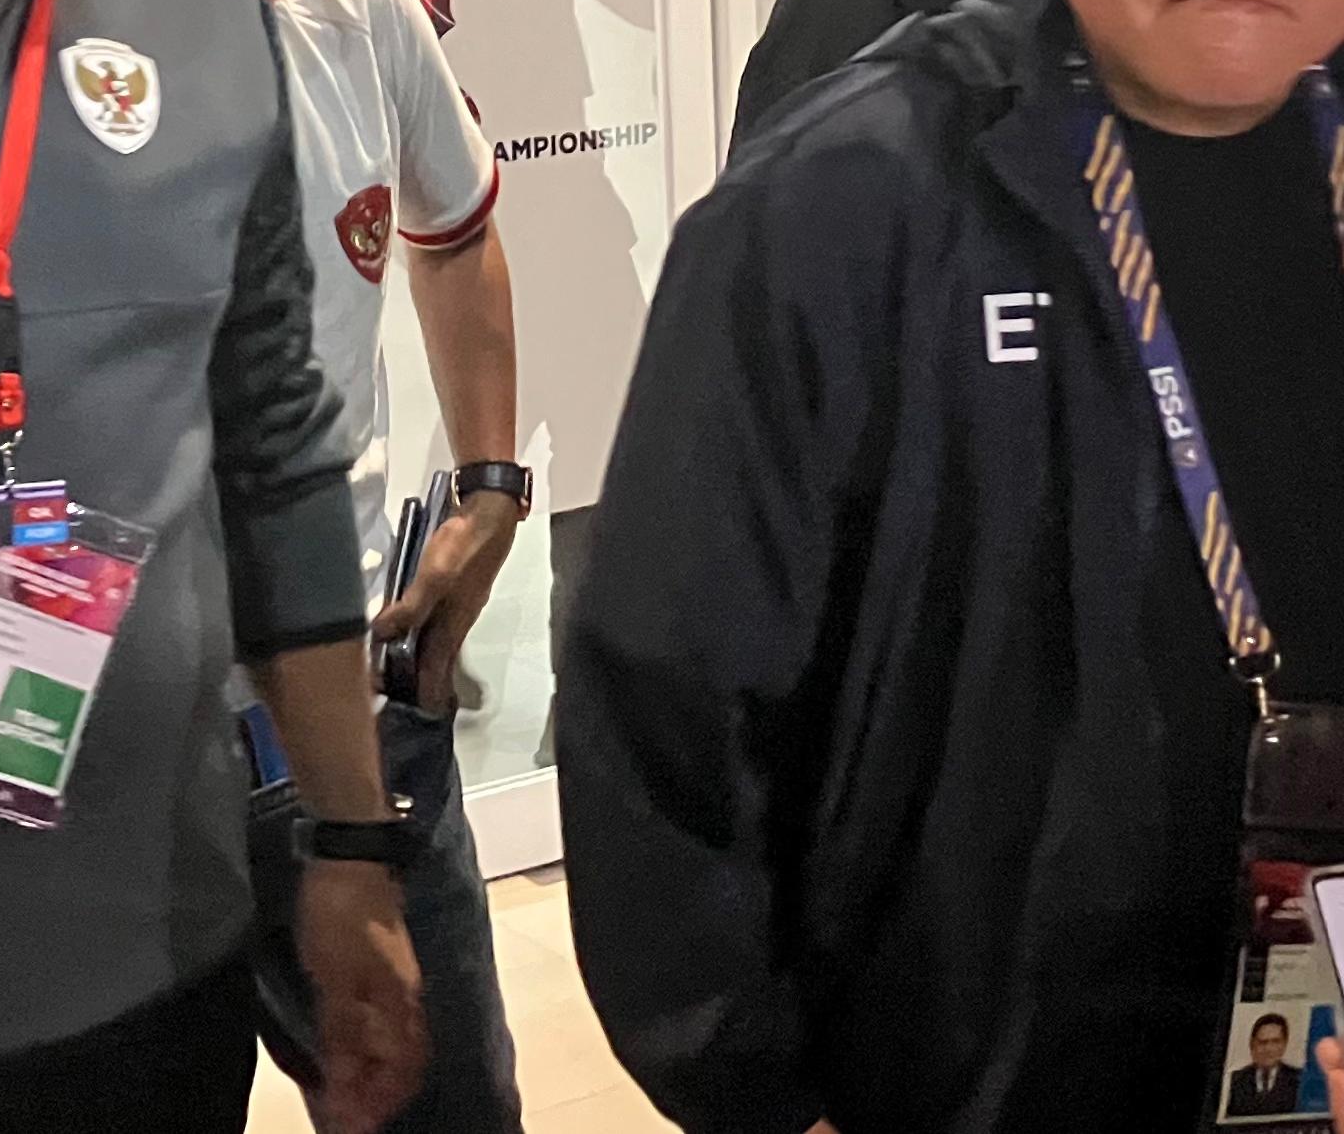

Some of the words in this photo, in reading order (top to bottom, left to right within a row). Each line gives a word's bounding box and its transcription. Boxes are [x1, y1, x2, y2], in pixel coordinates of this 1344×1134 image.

[494, 122, 658, 163] AMPIONSHIP
[982, 292, 1053, 363] E
[1147, 366, 1193, 440] PSSI
